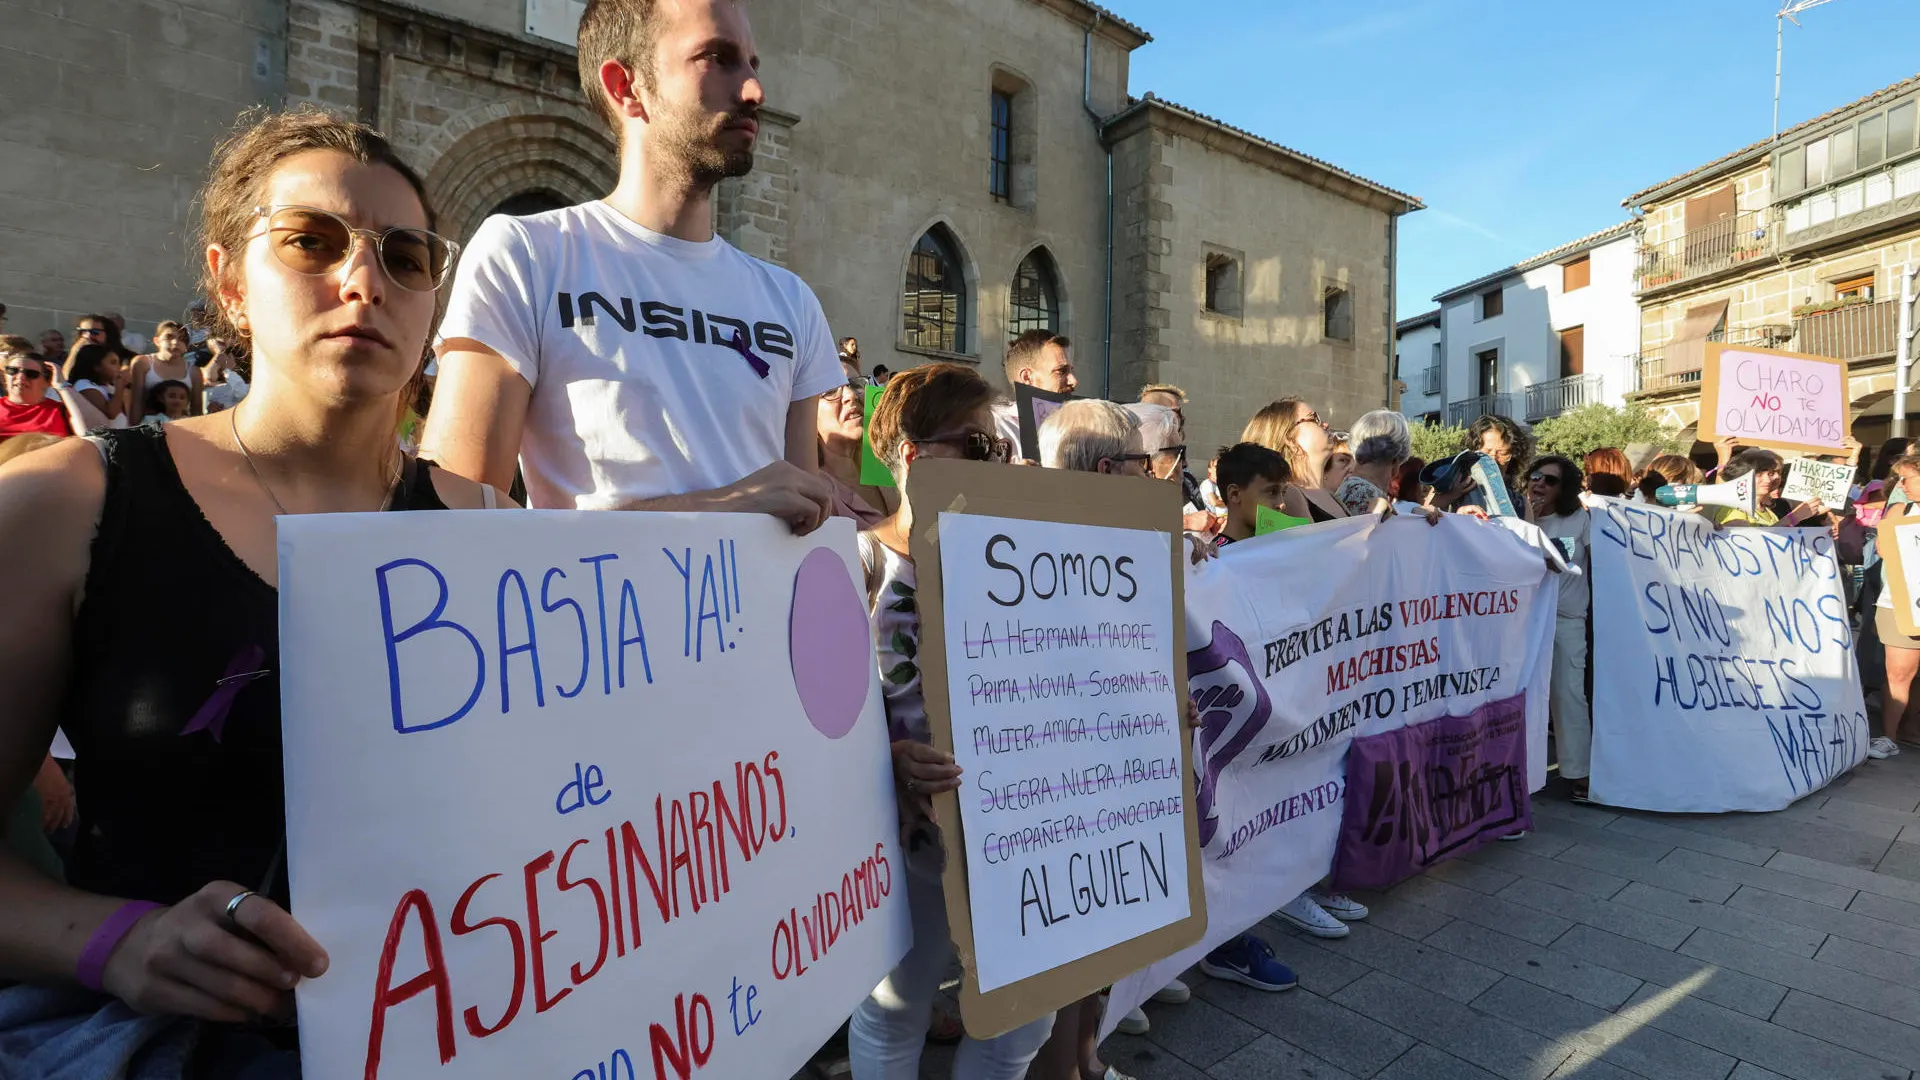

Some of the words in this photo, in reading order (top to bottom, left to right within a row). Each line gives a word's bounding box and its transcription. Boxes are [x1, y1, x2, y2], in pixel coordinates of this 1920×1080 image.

[557, 291, 794, 360] INSIDE
[1736, 360, 1824, 395] CHARO
[1751, 392, 1782, 411] NO
[1725, 408, 1841, 441] OLVIDAMOS
[1793, 459, 1852, 483] ¡HARTAS!
[1802, 474, 1836, 491] TODAS
[375, 553, 654, 735] BASTA
[662, 538, 745, 662] YA!!
[964, 619, 997, 659] LA
[1264, 616, 1334, 679] FRENTE
[1336, 613, 1352, 644] A
[1355, 602, 1393, 639] LAS
[1399, 589, 1518, 628] VIOLENCIAS
[1764, 594, 1851, 654] NOS
[1401, 666, 1501, 713] FEMINISTA
[556, 762, 613, 815] de
[1216, 780, 1340, 861] MOVIMIENTO
[1020, 832, 1169, 937] ALGUIEN
[648, 991, 716, 1080] NO
[727, 976, 762, 1037] te
[771, 842, 891, 981] OLVIDAMOS
